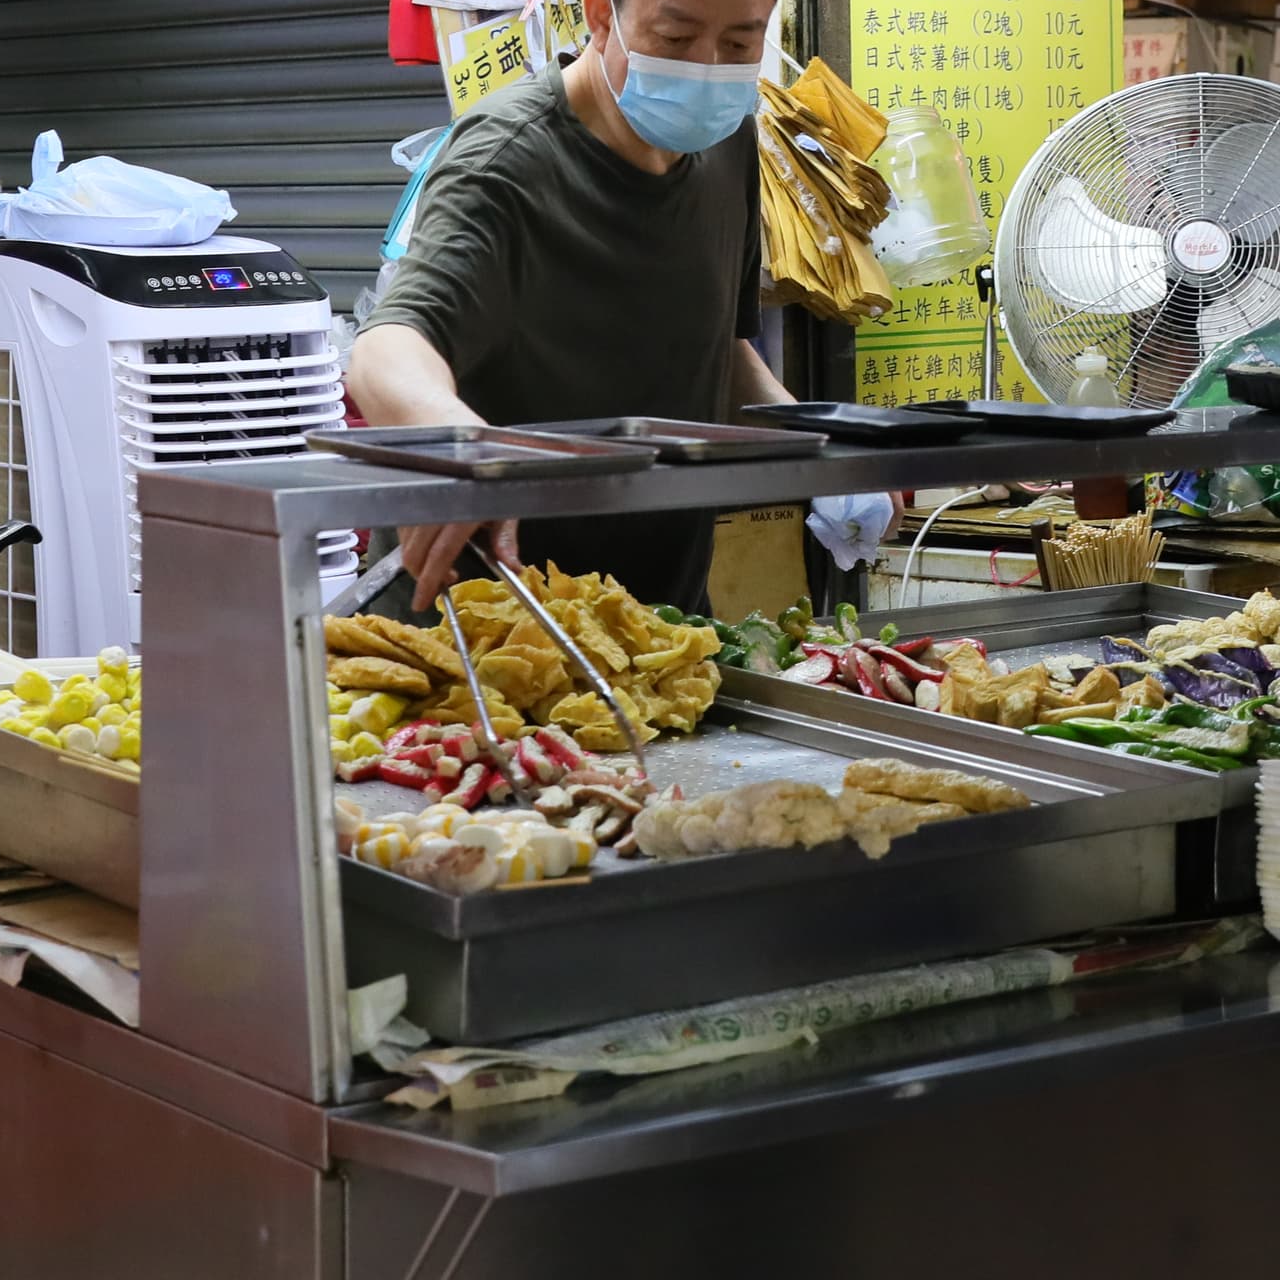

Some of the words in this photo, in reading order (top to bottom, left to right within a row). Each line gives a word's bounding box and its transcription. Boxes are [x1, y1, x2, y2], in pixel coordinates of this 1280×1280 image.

[863, 8, 949, 35] 泰式蝦餅
[973, 10, 1023, 37] (2塊)
[1046, 12, 1084, 36] 10元
[866, 44, 1023, 71] 日式紫薯餅(1塊)
[1046, 46, 1084, 70] 10元
[1047, 85, 1085, 109] 10元
